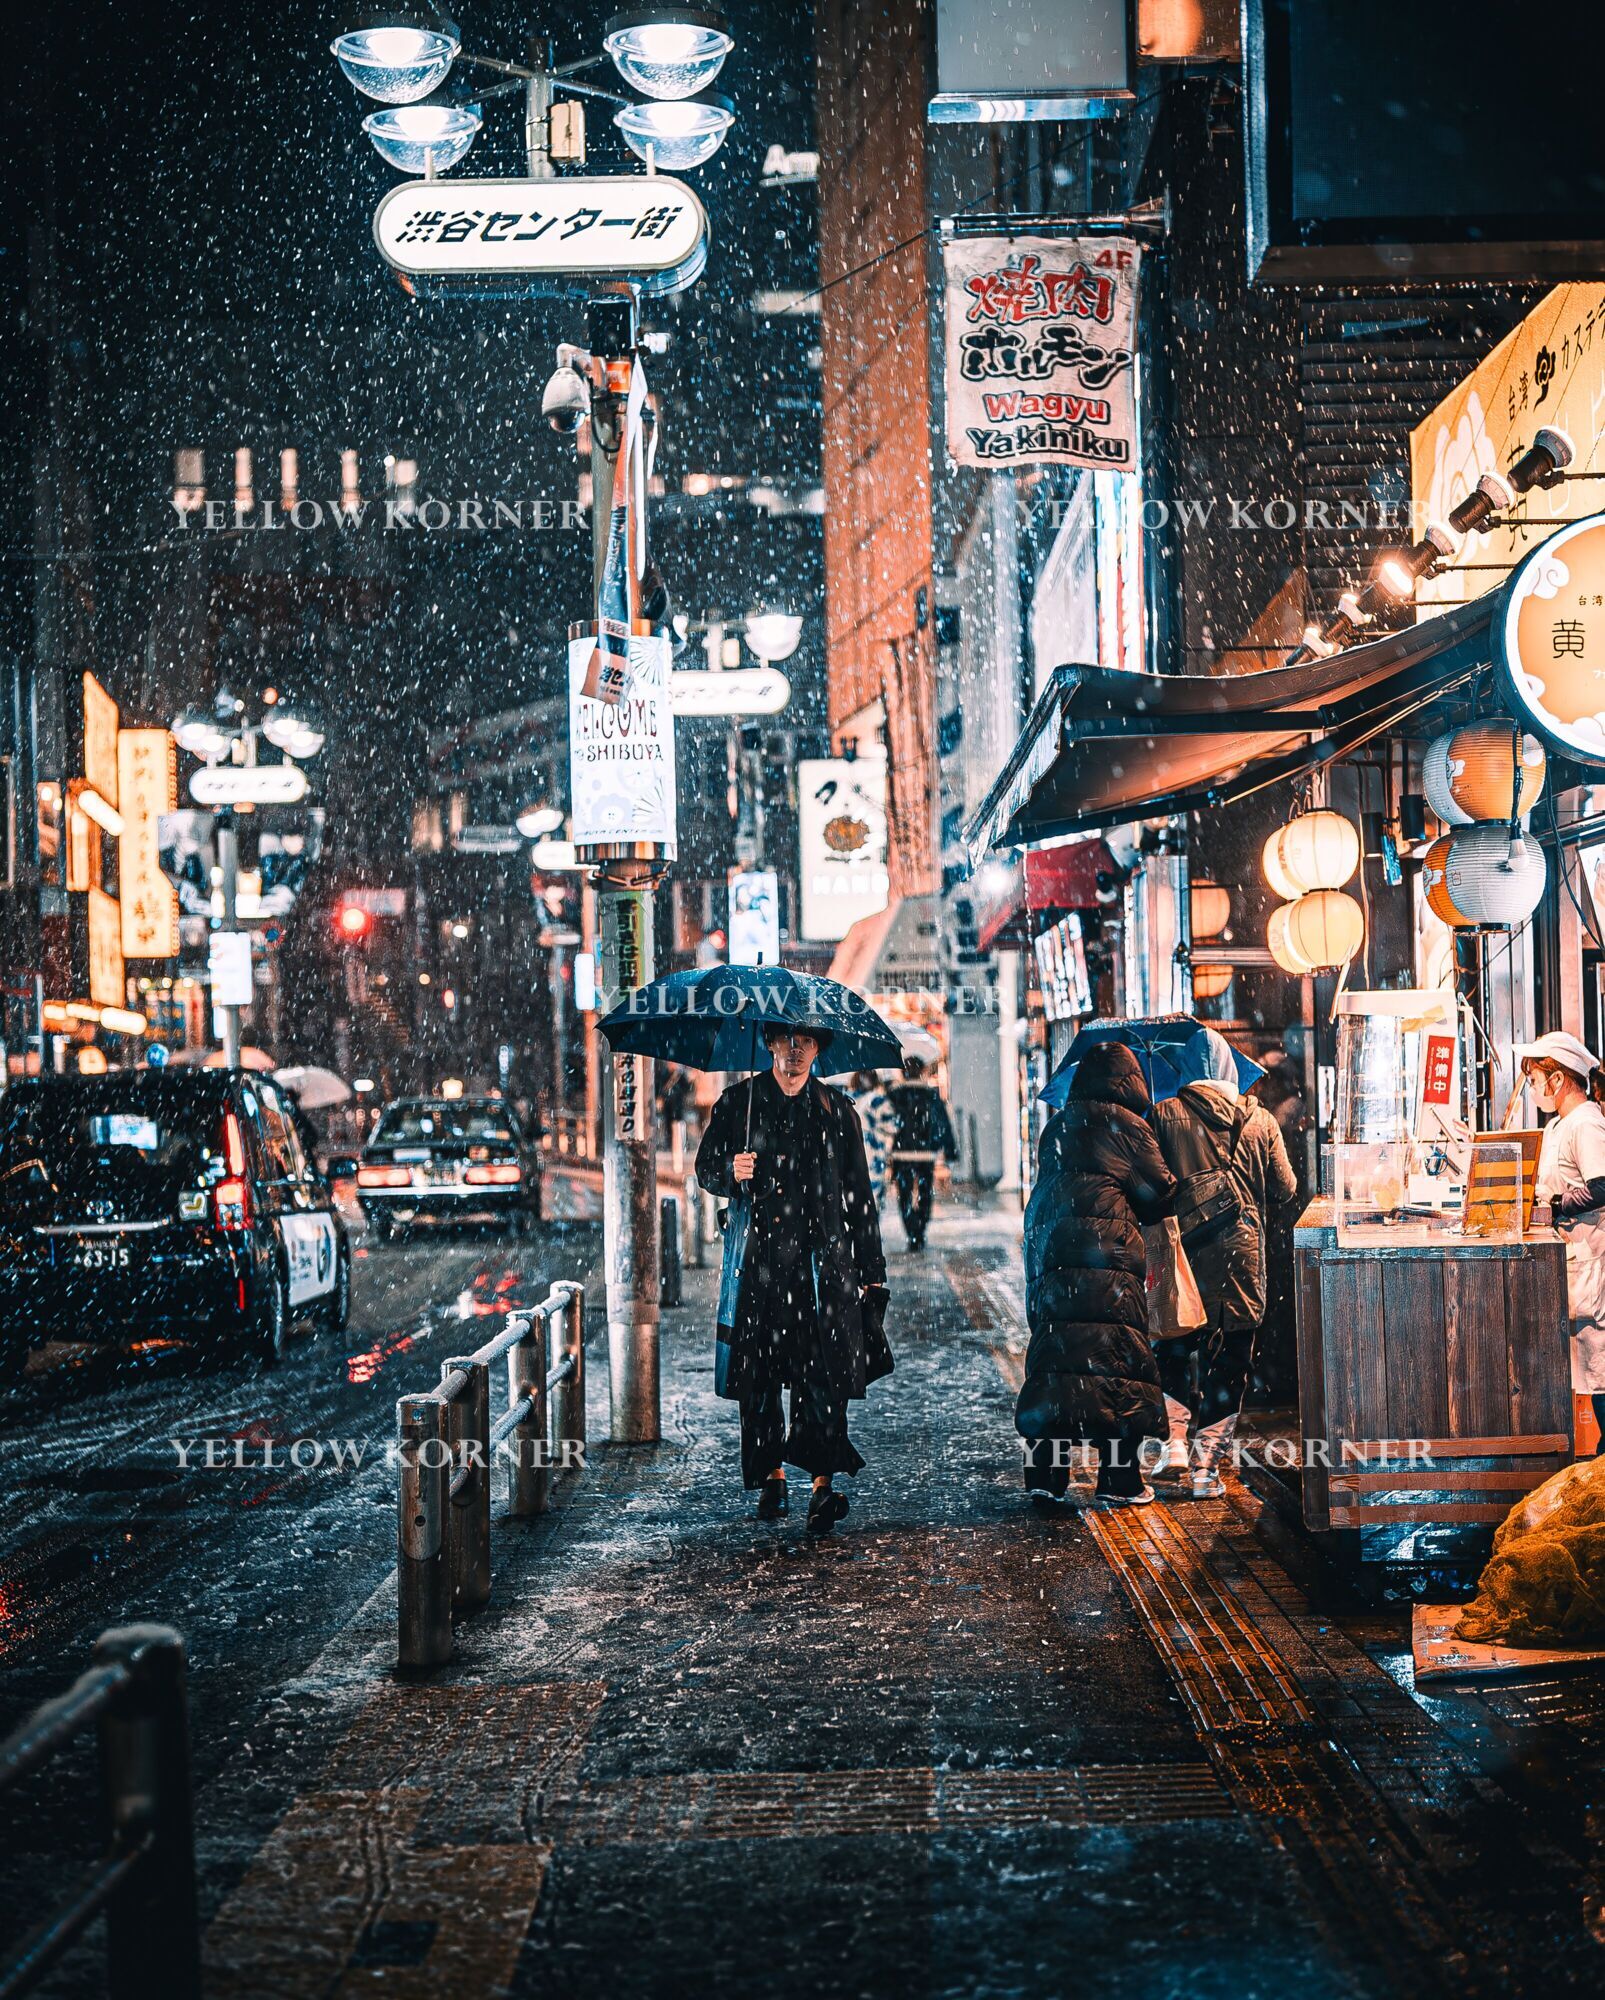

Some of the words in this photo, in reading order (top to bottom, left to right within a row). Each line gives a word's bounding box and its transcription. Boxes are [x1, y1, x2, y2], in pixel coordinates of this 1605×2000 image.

[395, 206, 683, 243] 渋谷センター街
[1094, 249, 1133, 270] 4F
[964, 255, 1115, 324] 焼肉
[961, 325, 1132, 388] ホルモン
[983, 391, 1110, 425] Wagyu
[967, 424, 1128, 462] Yakiniku
[1551, 618, 1586, 659] 黄
[587, 743, 664, 762] SHIBUYA
[1433, 1046, 1451, 1094] 準備中
